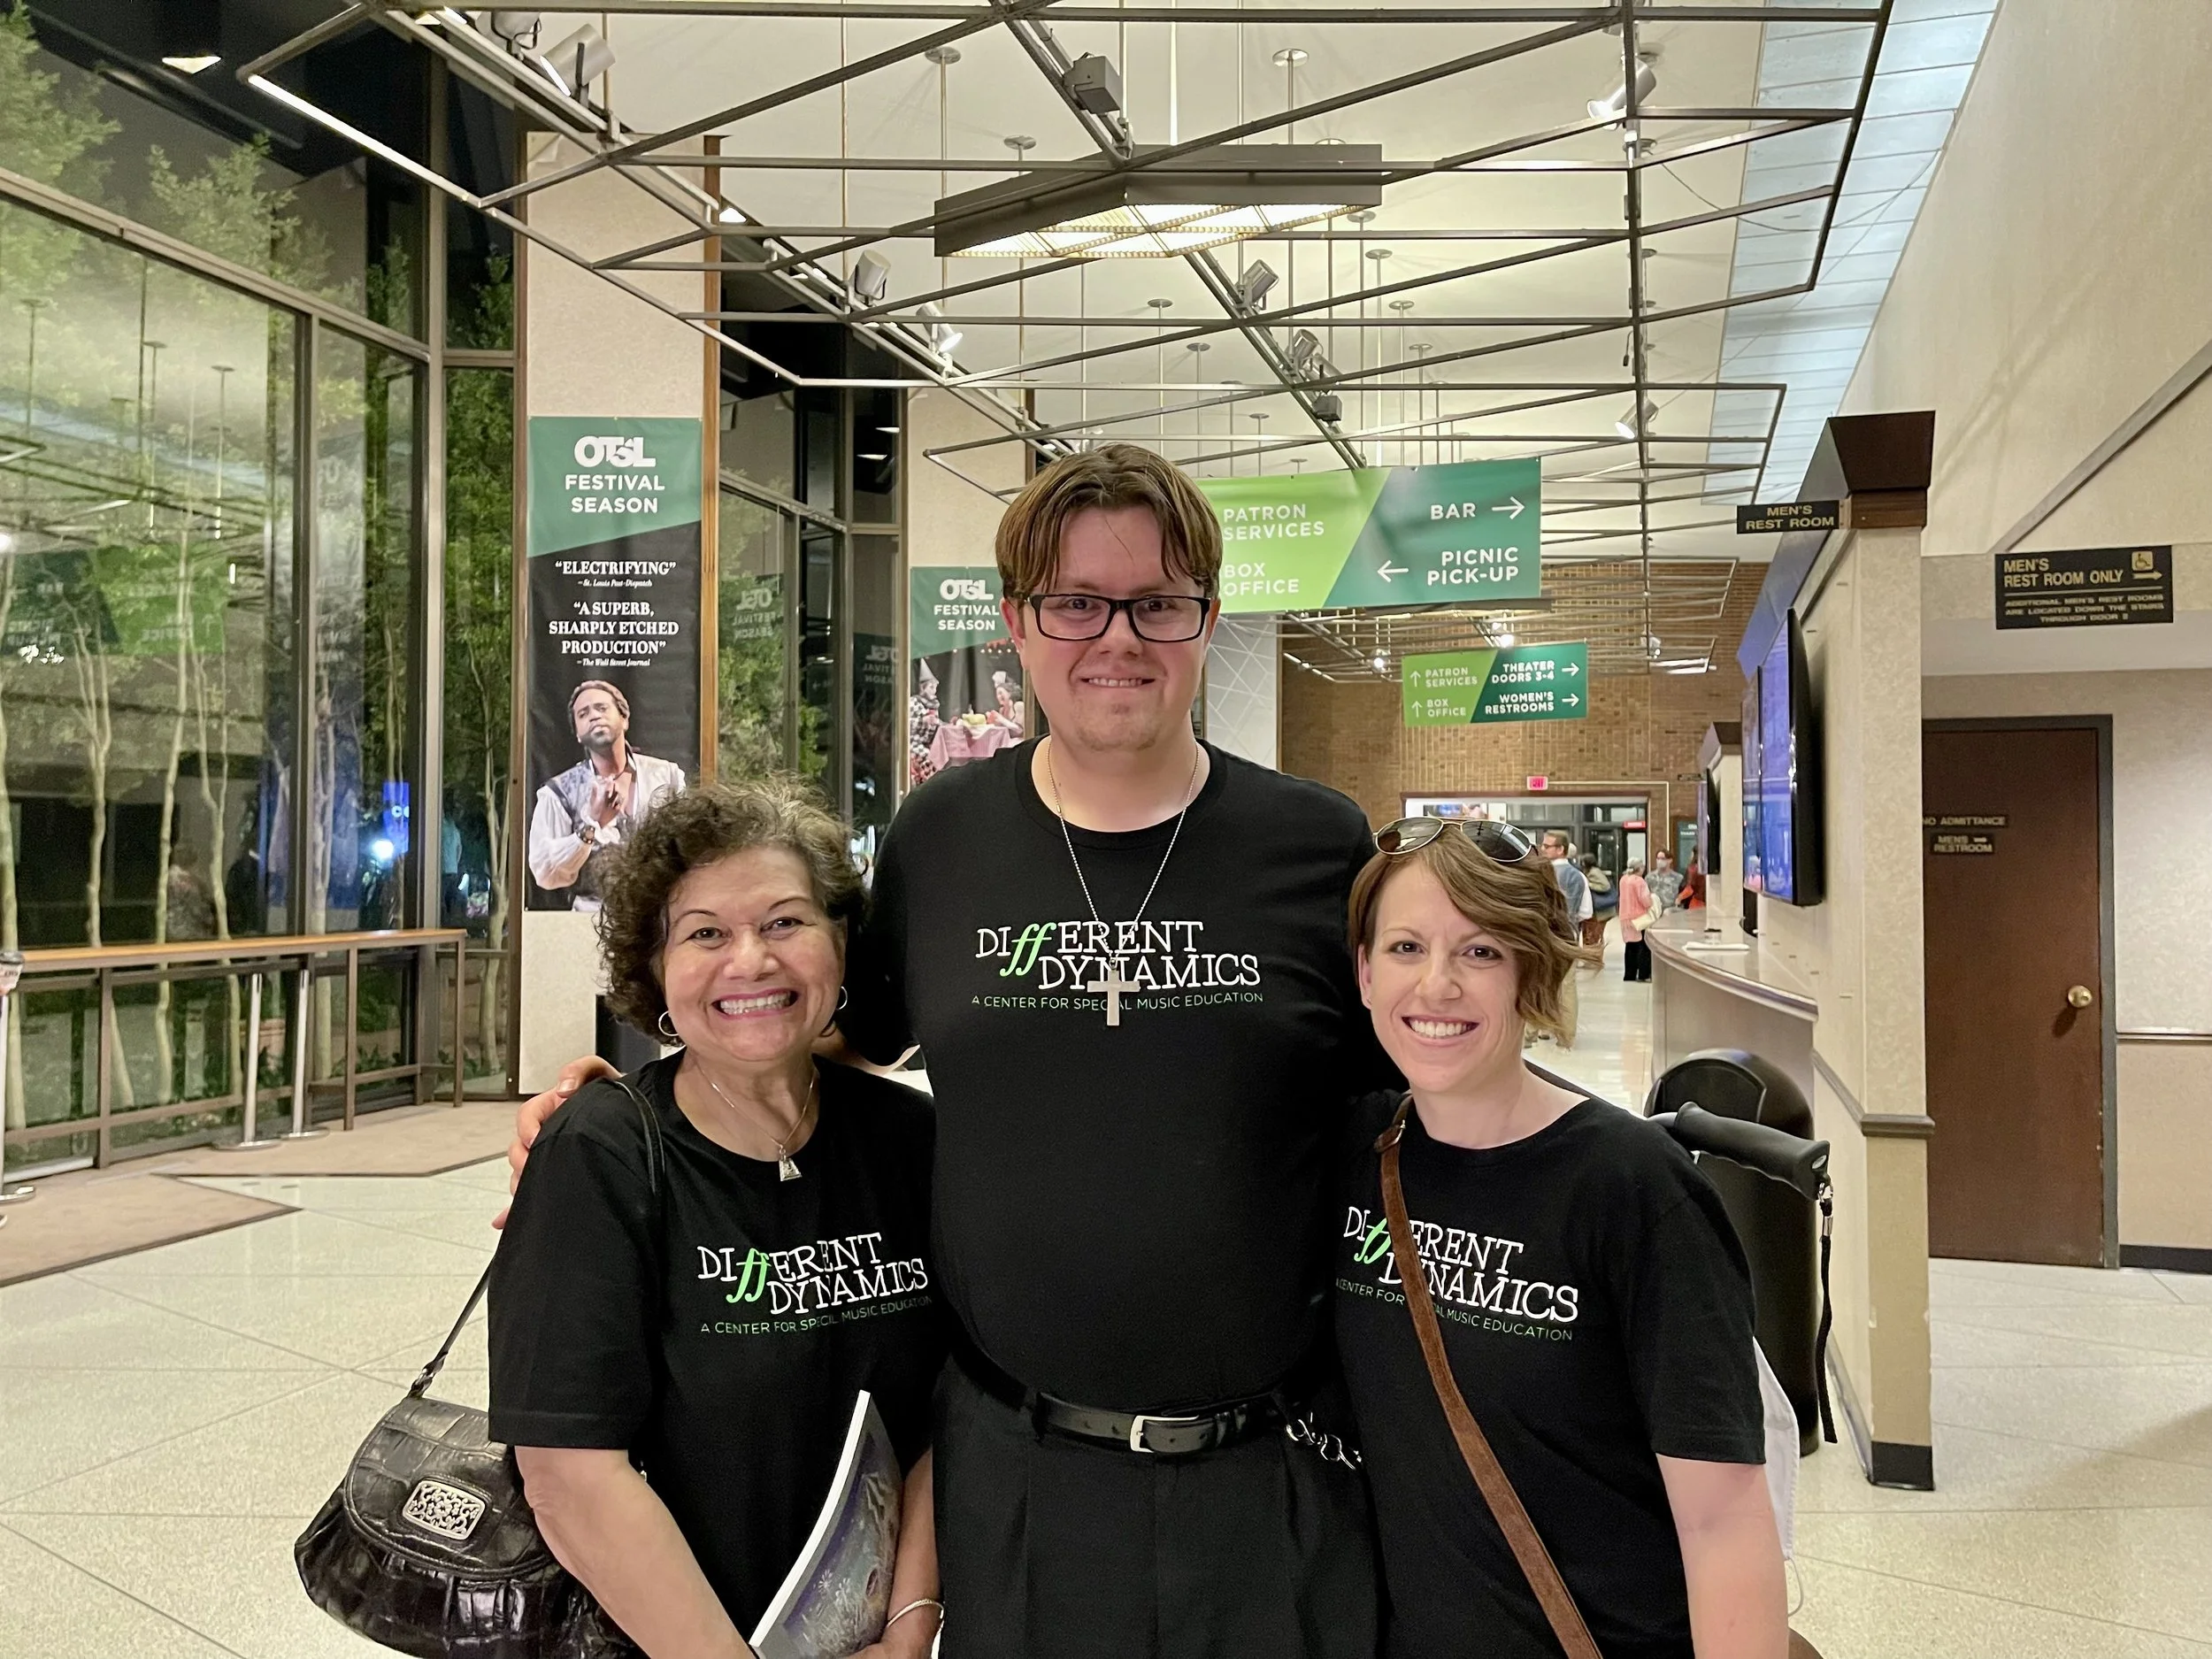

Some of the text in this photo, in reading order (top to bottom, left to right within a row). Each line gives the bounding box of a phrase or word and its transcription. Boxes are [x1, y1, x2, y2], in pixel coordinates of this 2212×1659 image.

[574, 435, 656, 467] OTSL
[565, 474, 664, 490] FESTIVAL
[571, 497, 658, 513] SEASON
[1430, 502, 1478, 520] BAR
[1767, 504, 1813, 517] MEN'S
[1223, 503, 1307, 523] PATRON
[1746, 516, 1834, 530] REST ROOM
[1223, 521, 1325, 541] SERVICES
[1440, 547, 1519, 566] PICNIC
[1224, 562, 1266, 579] BOX
[2003, 558, 2049, 572] MEN'S
[1426, 566, 1519, 587] PICK-UP
[2003, 569, 2124, 588] REST ROOM ONLY
[940, 579, 995, 601] OTSL
[1224, 578, 1300, 596] OFFICE
[592, 602, 654, 617] SUPERB,
[933, 604, 1000, 616] FESTIVAL
[549, 621, 680, 634] SHARPLY ETCHED
[938, 619, 995, 631] SEASON
[561, 641, 666, 654] PRODUCTION”
[1425, 667, 1469, 679] PATRON
[1502, 660, 1555, 672] THEATER
[1425, 676, 1478, 688] SERVICES
[1491, 672, 1532, 684] DOORS
[1426, 698, 1449, 708] BOX
[1499, 691, 1555, 703] WOMEN'S
[1427, 707, 1466, 718] OFFICE
[1485, 702, 1555, 715] RESTROOMS
[972, 995, 980, 1004] A
[984, 996, 1036, 1009] CENTER
[1041, 997, 1069, 1010] FOR
[1137, 996, 1180, 1010] MUSIC
[1185, 992, 1263, 1006] EDUCATION
[701, 1323, 710, 1333] A
[715, 1322, 771, 1334] CENTER
[774, 1321, 796, 1333] FOR
[841, 1305, 879, 1323] MUSIC
[1376, 1289, 1405, 1306] FOR
[1447, 1308, 1481, 1326] MUSIC
[1483, 1317, 1573, 1341] EDUCATION
